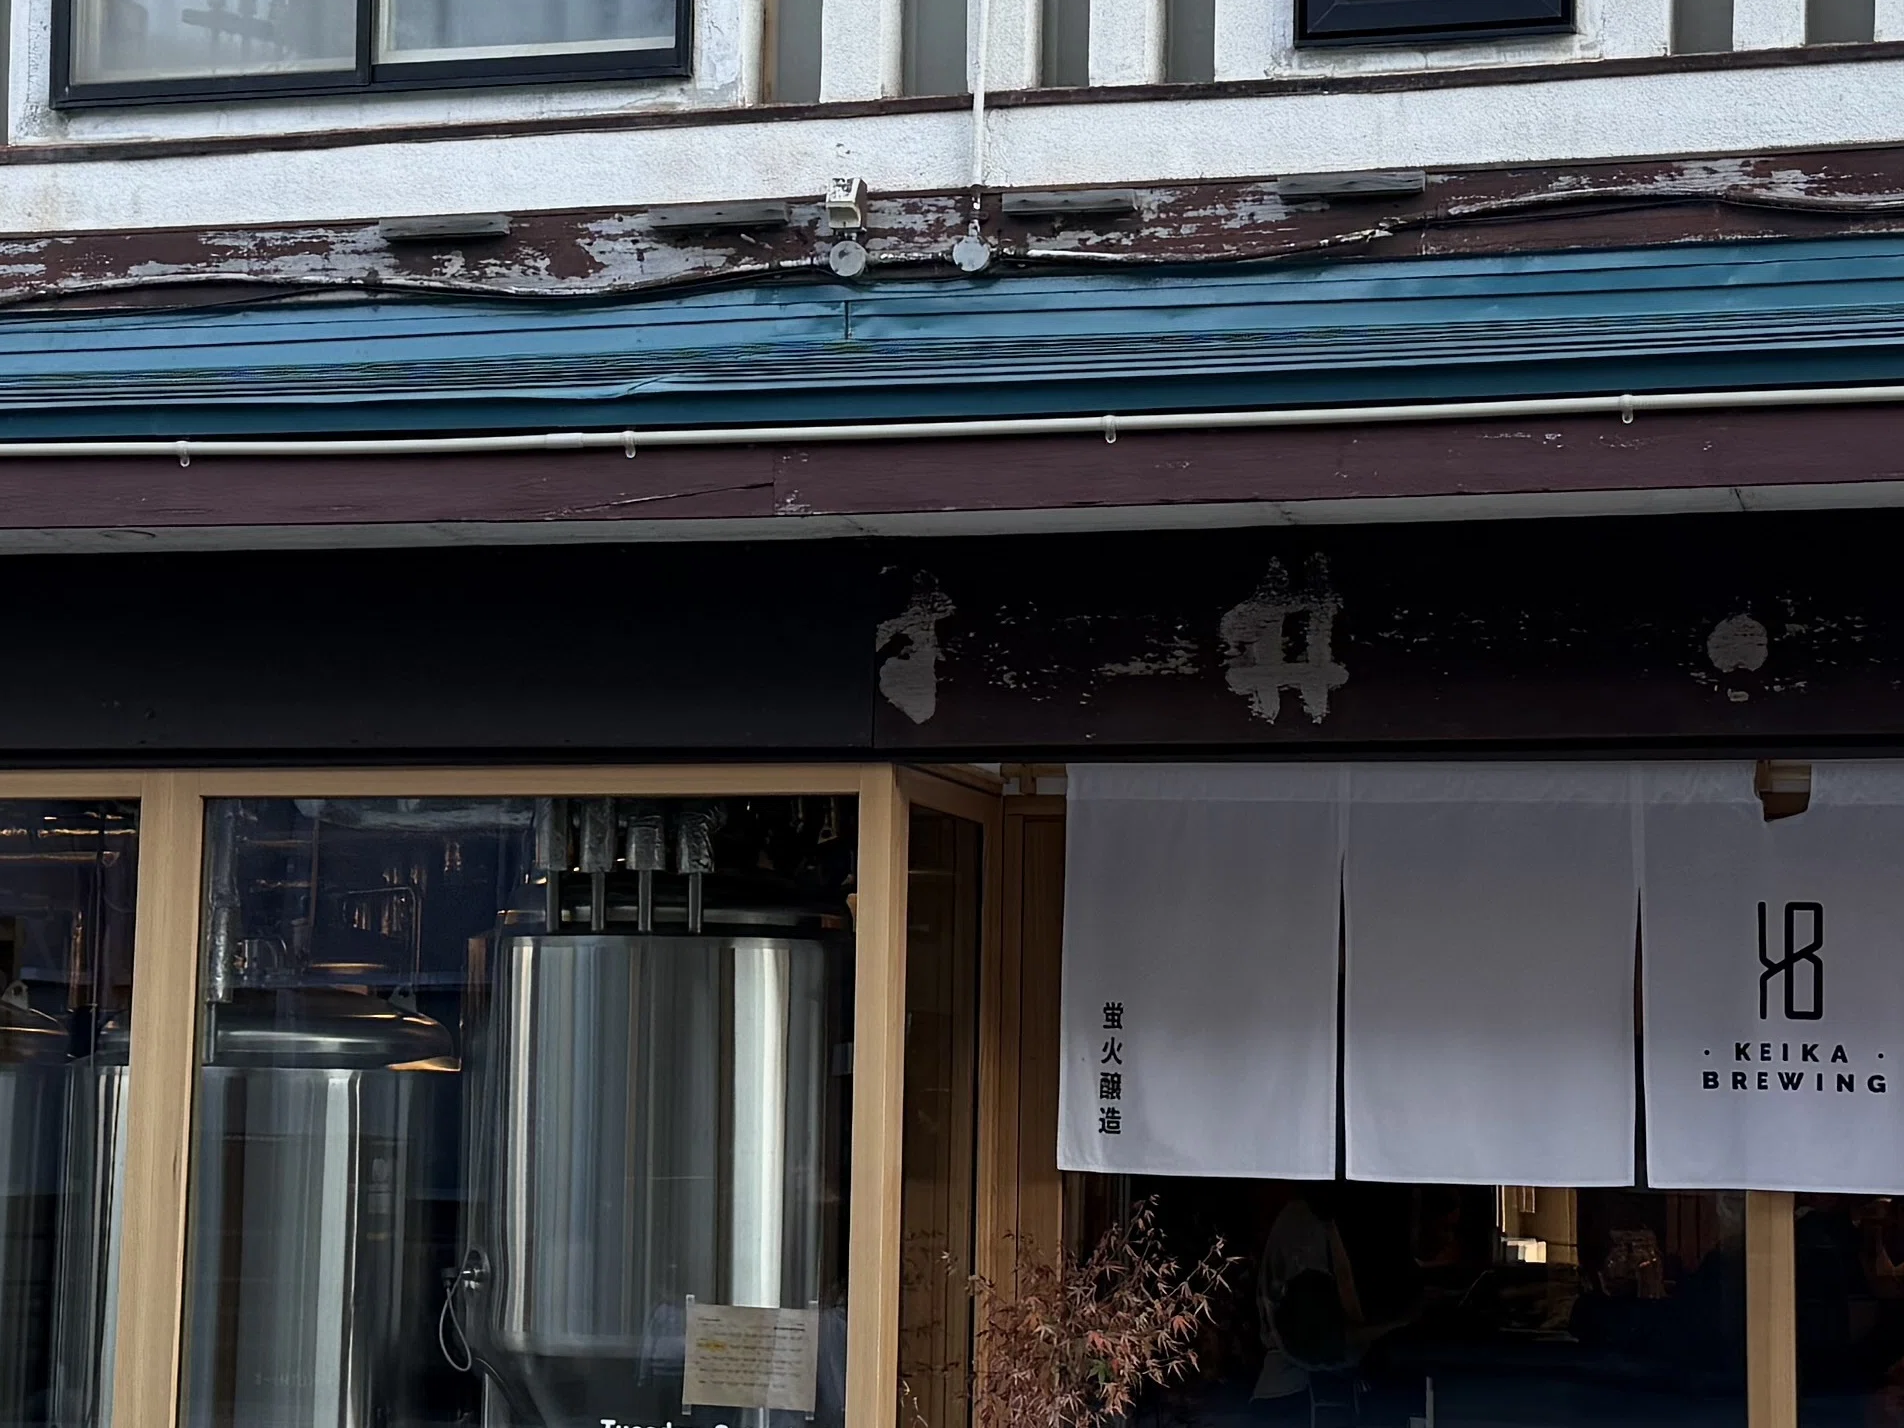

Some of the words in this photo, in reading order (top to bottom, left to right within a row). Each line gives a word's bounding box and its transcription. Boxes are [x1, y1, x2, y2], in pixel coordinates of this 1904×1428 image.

[1734, 1042, 1848, 1063] KEIKA
[1098, 1001, 1124, 1135] 蛍火醸造
[1702, 1070, 1886, 1093] BREWING
